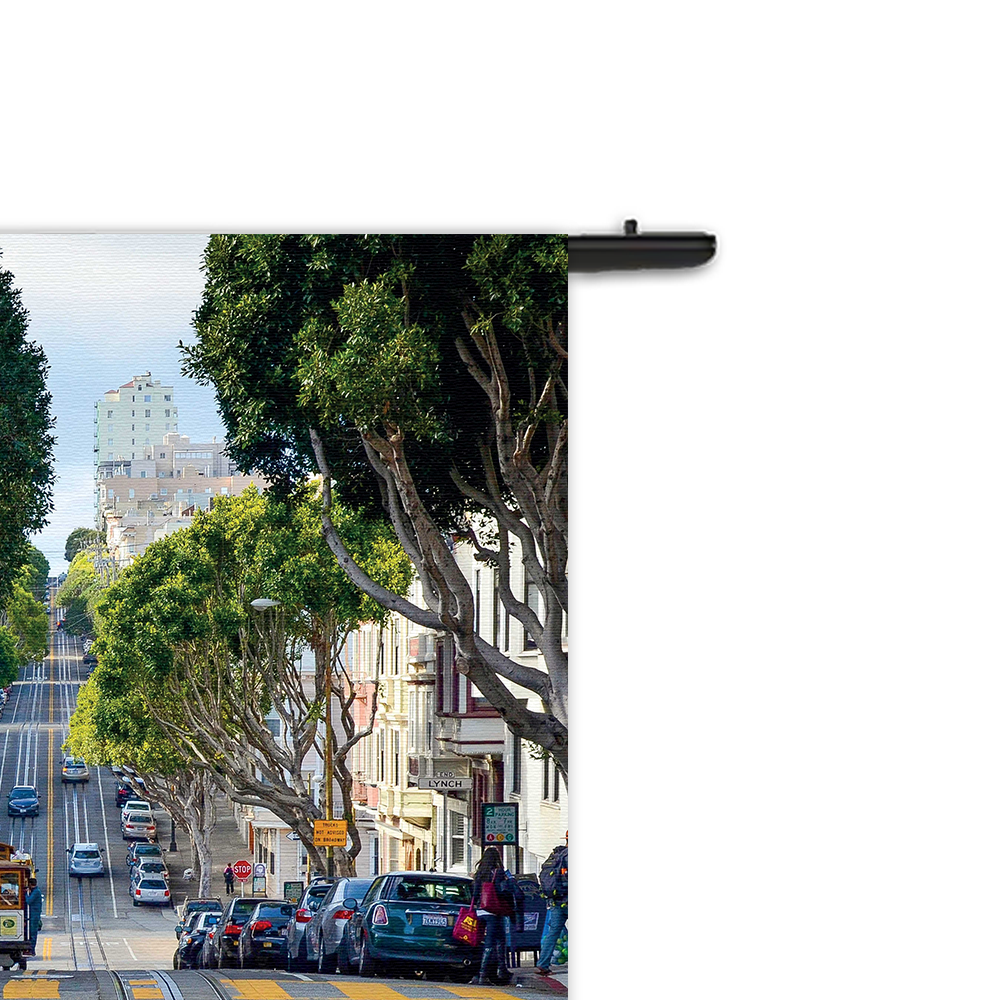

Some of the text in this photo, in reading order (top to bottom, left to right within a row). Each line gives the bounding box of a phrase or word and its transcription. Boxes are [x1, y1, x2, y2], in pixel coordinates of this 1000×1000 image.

[428, 780, 462, 788] LYNCH
[486, 807, 493, 815] 2
[234, 865, 251, 873] STOP
